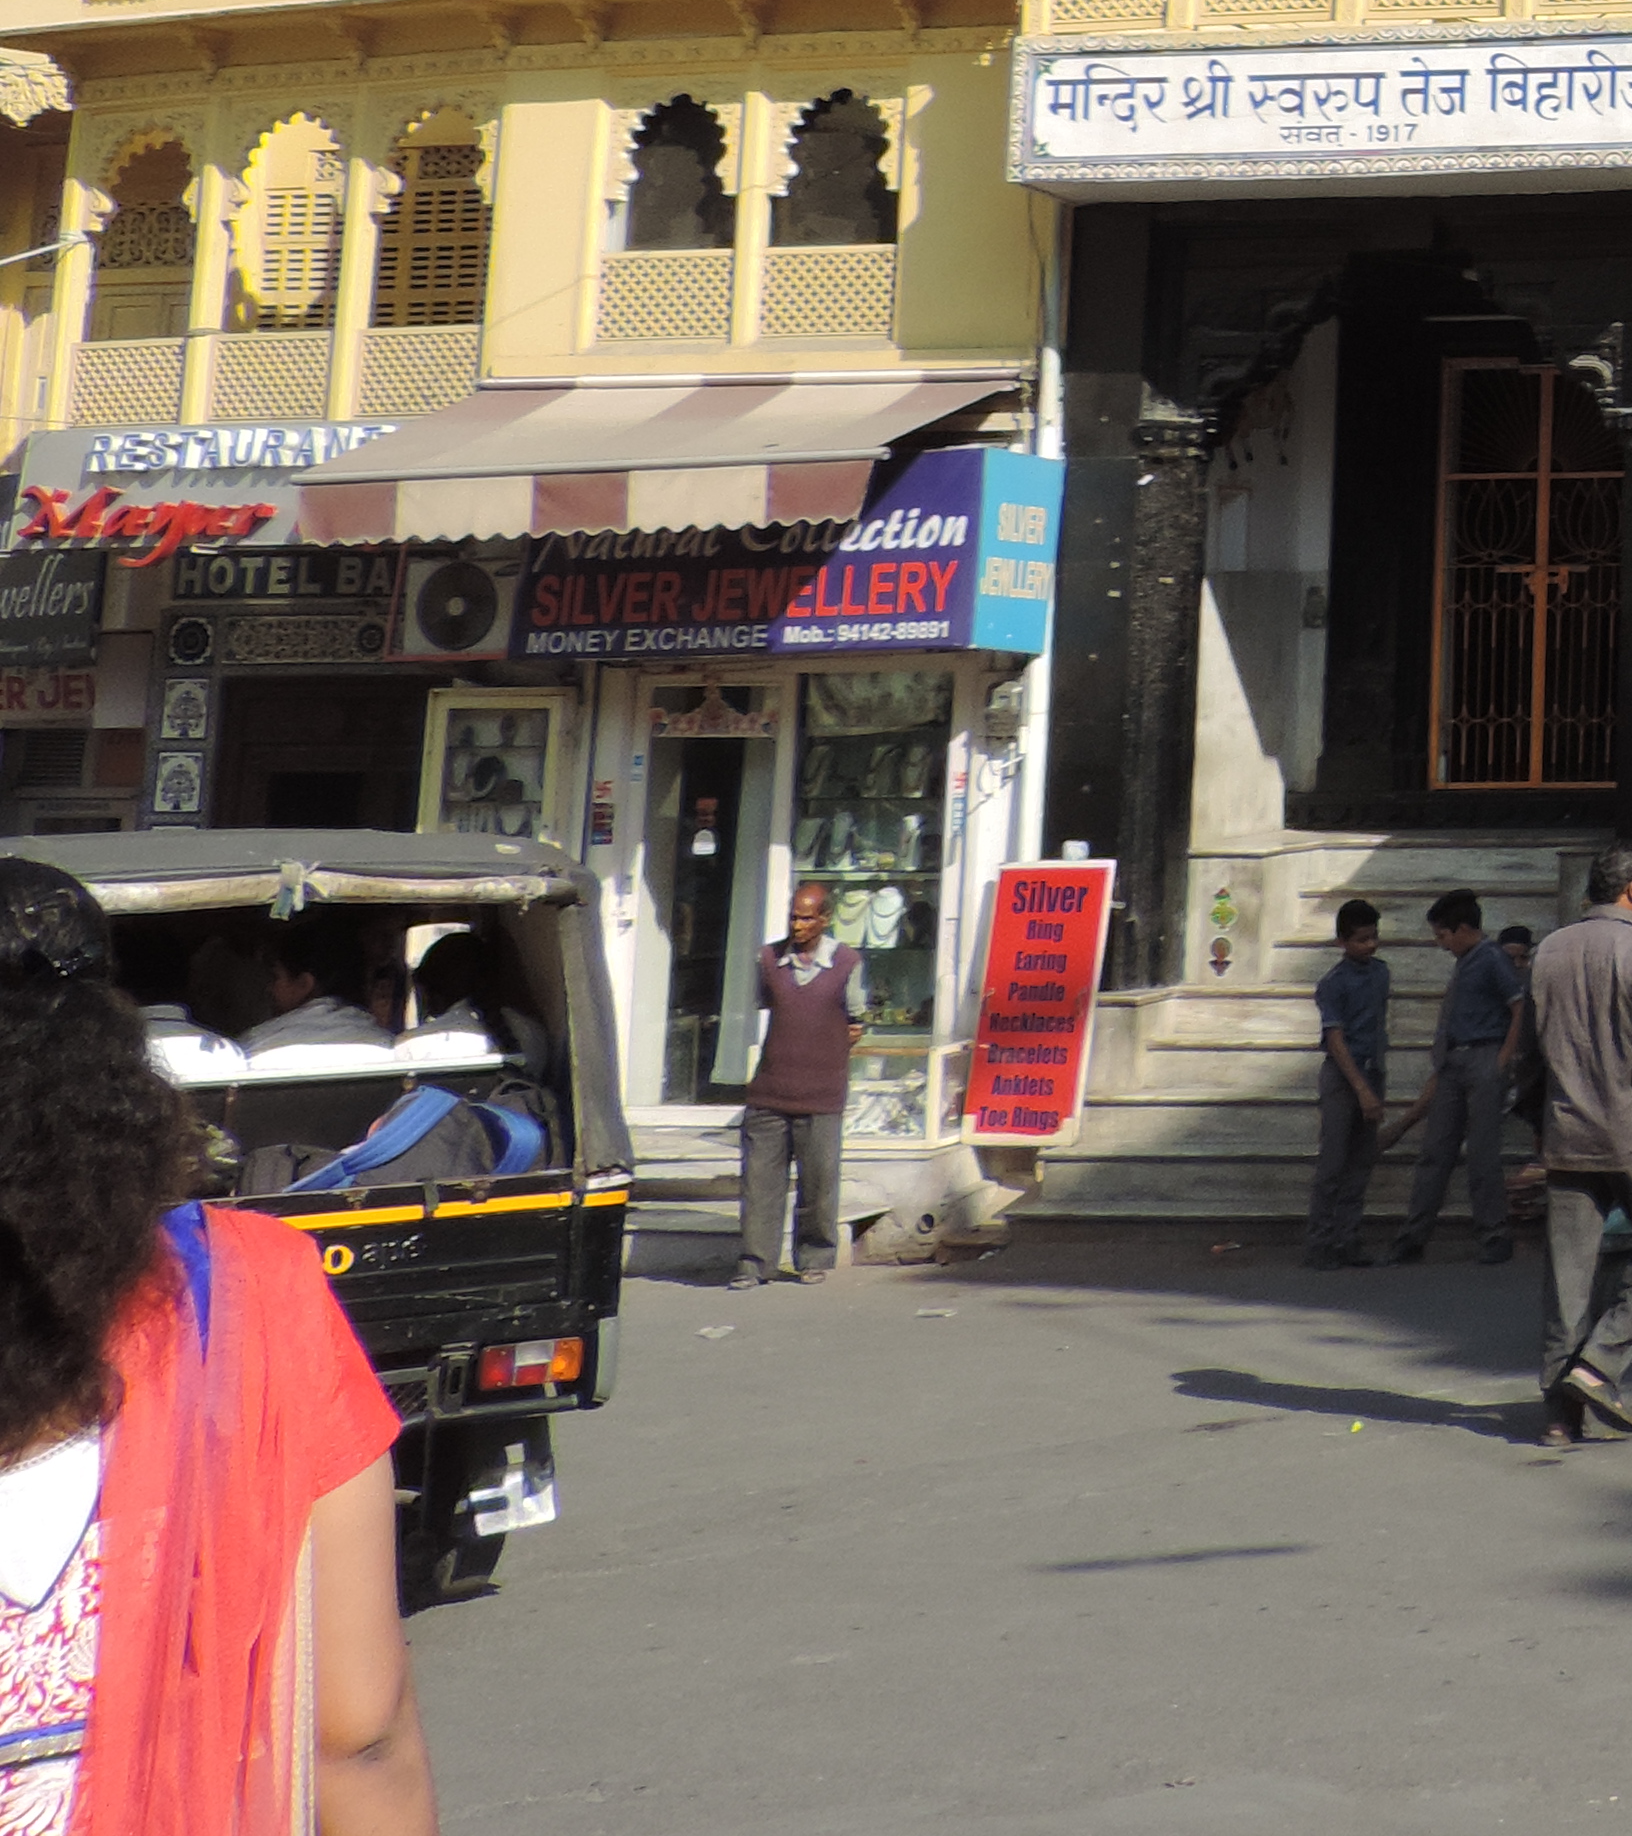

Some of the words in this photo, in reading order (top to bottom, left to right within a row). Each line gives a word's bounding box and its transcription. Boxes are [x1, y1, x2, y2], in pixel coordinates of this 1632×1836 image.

[1047, 63, 1167, 133] मन्दिर
[1181, 59, 1234, 120] श्री
[1400, 56, 1470, 116] तेज
[1365, 123, 1418, 143] 1917
[16, 484, 279, 568] Mayur
[997, 502, 1047, 545] SILVER
[176, 555, 322, 596] HOTEL
[530, 570, 683, 628] SILVER
[690, 559, 959, 623] JEWELLERY
[525, 627, 622, 654] MONEY
[623, 623, 770, 652] EXCHANGE
[1011, 879, 1090, 914] Silver
[1026, 919, 1065, 943] Ring
[1014, 950, 1067, 974] Earing
[986, 1043, 1069, 1064] Bracelets
[991, 1075, 1055, 1096] Anklets
[978, 1107, 1008, 1127] Toe
[1011, 1107, 1060, 1131] Rings
